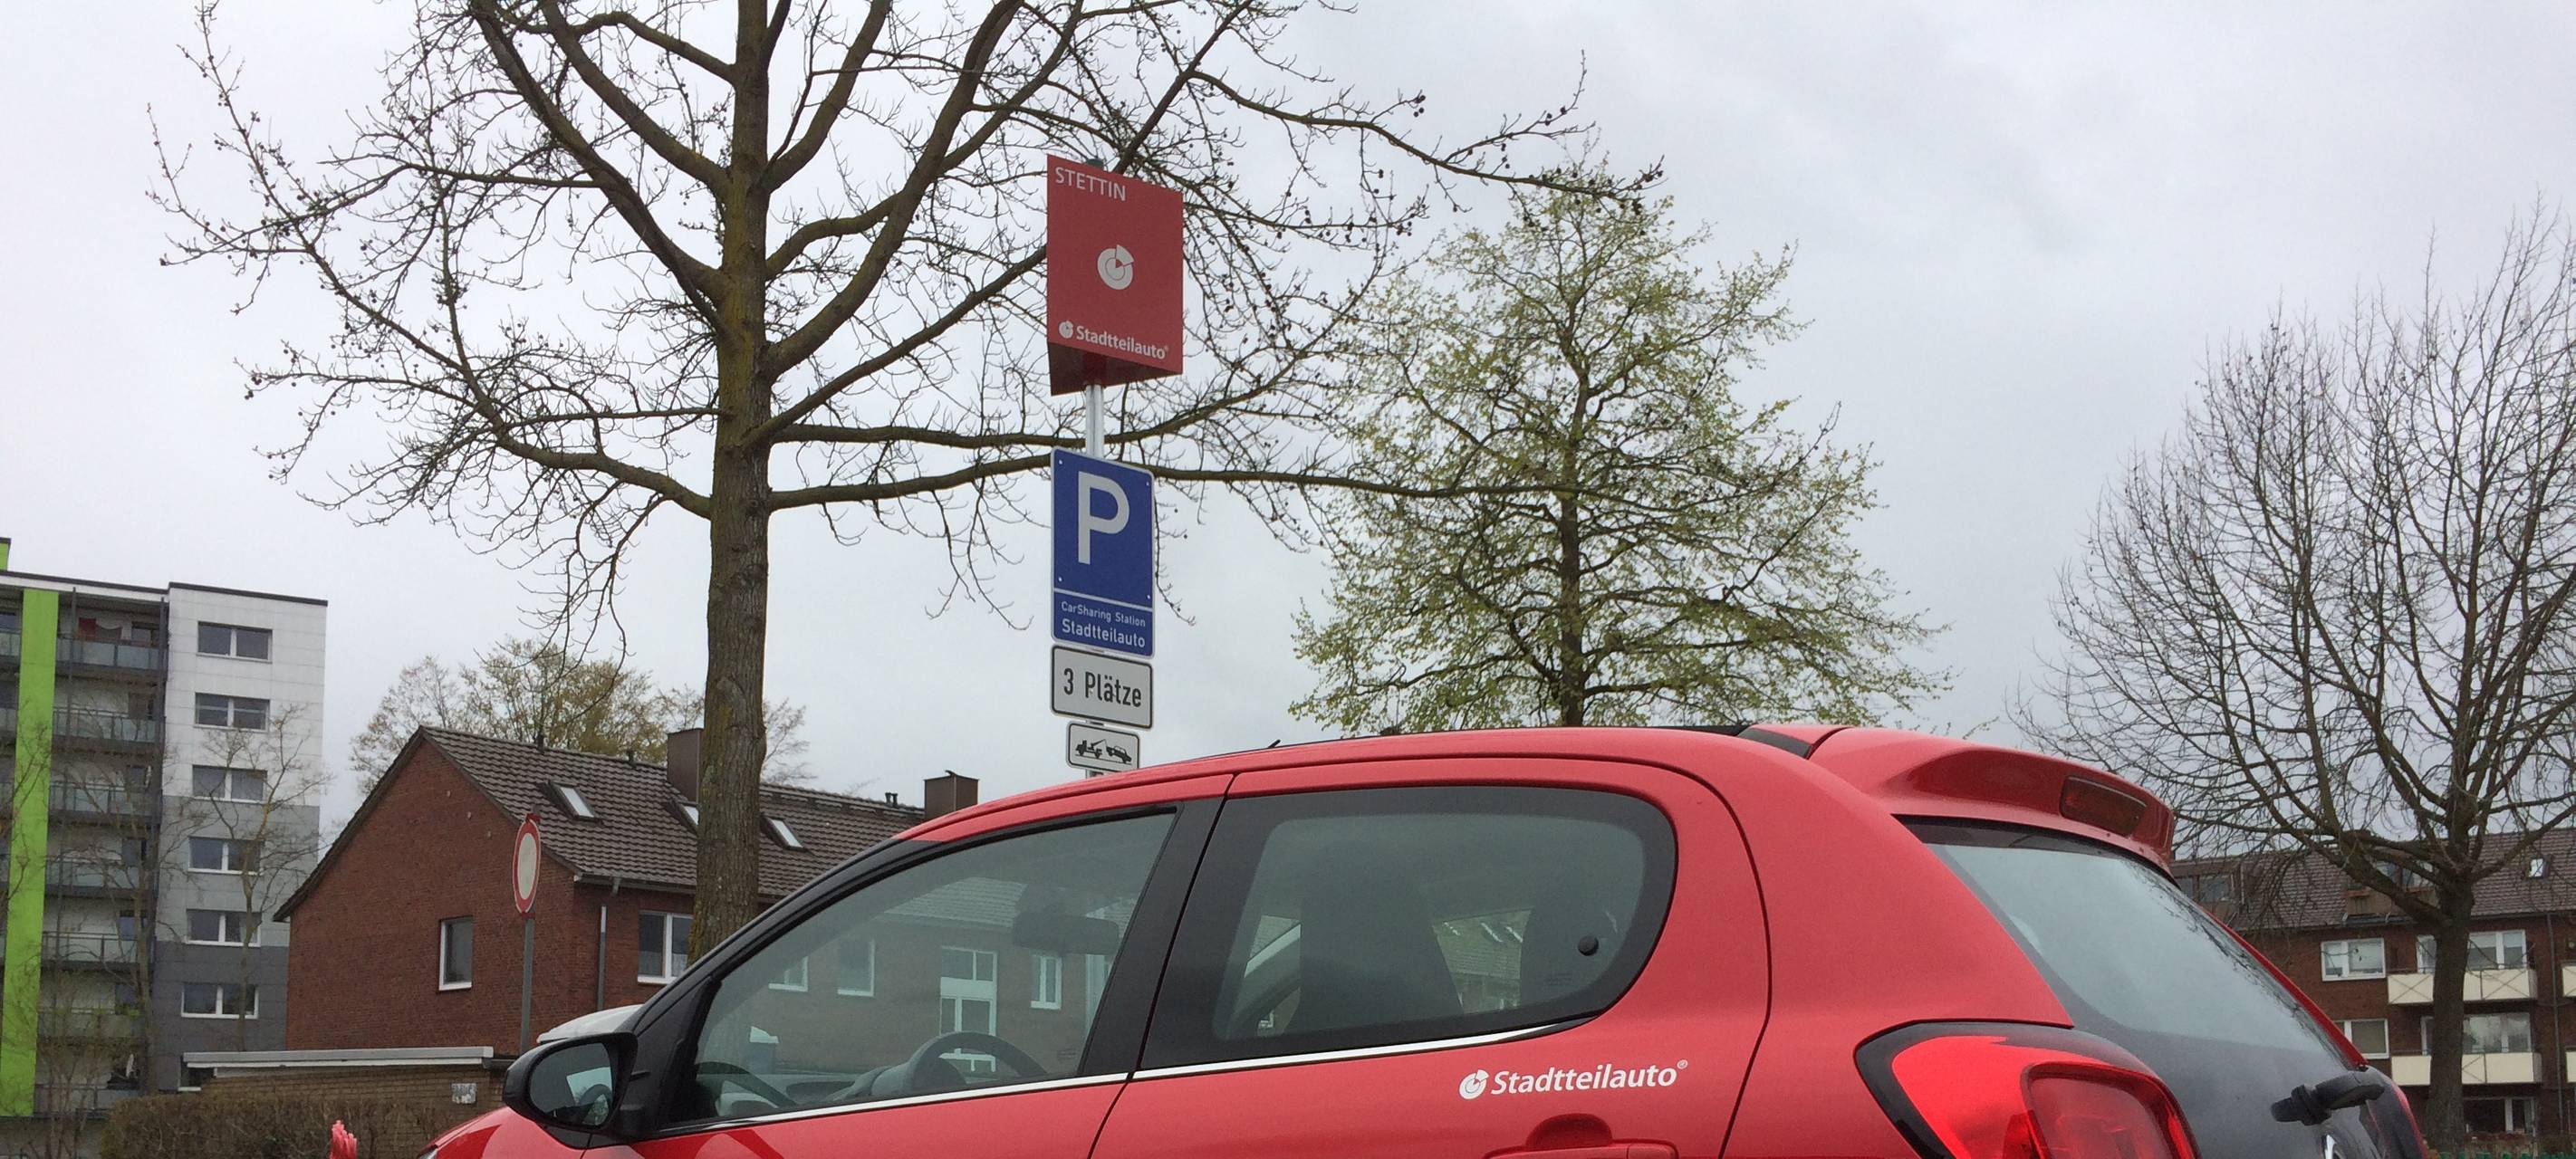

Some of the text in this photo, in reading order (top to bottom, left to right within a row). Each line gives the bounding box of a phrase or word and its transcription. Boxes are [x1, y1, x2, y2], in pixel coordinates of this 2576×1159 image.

[1054, 166, 1126, 202] STETTIN
[1076, 325, 1166, 359] Stadtteilauto
[1078, 470, 1130, 565] P
[1061, 600, 1146, 627] CarSharing Station
[1062, 618, 1146, 648] Stadtteilauto
[1063, 667, 1141, 707] 3 Plätze
[1491, 1063, 1677, 1095] Stadtteilauto
